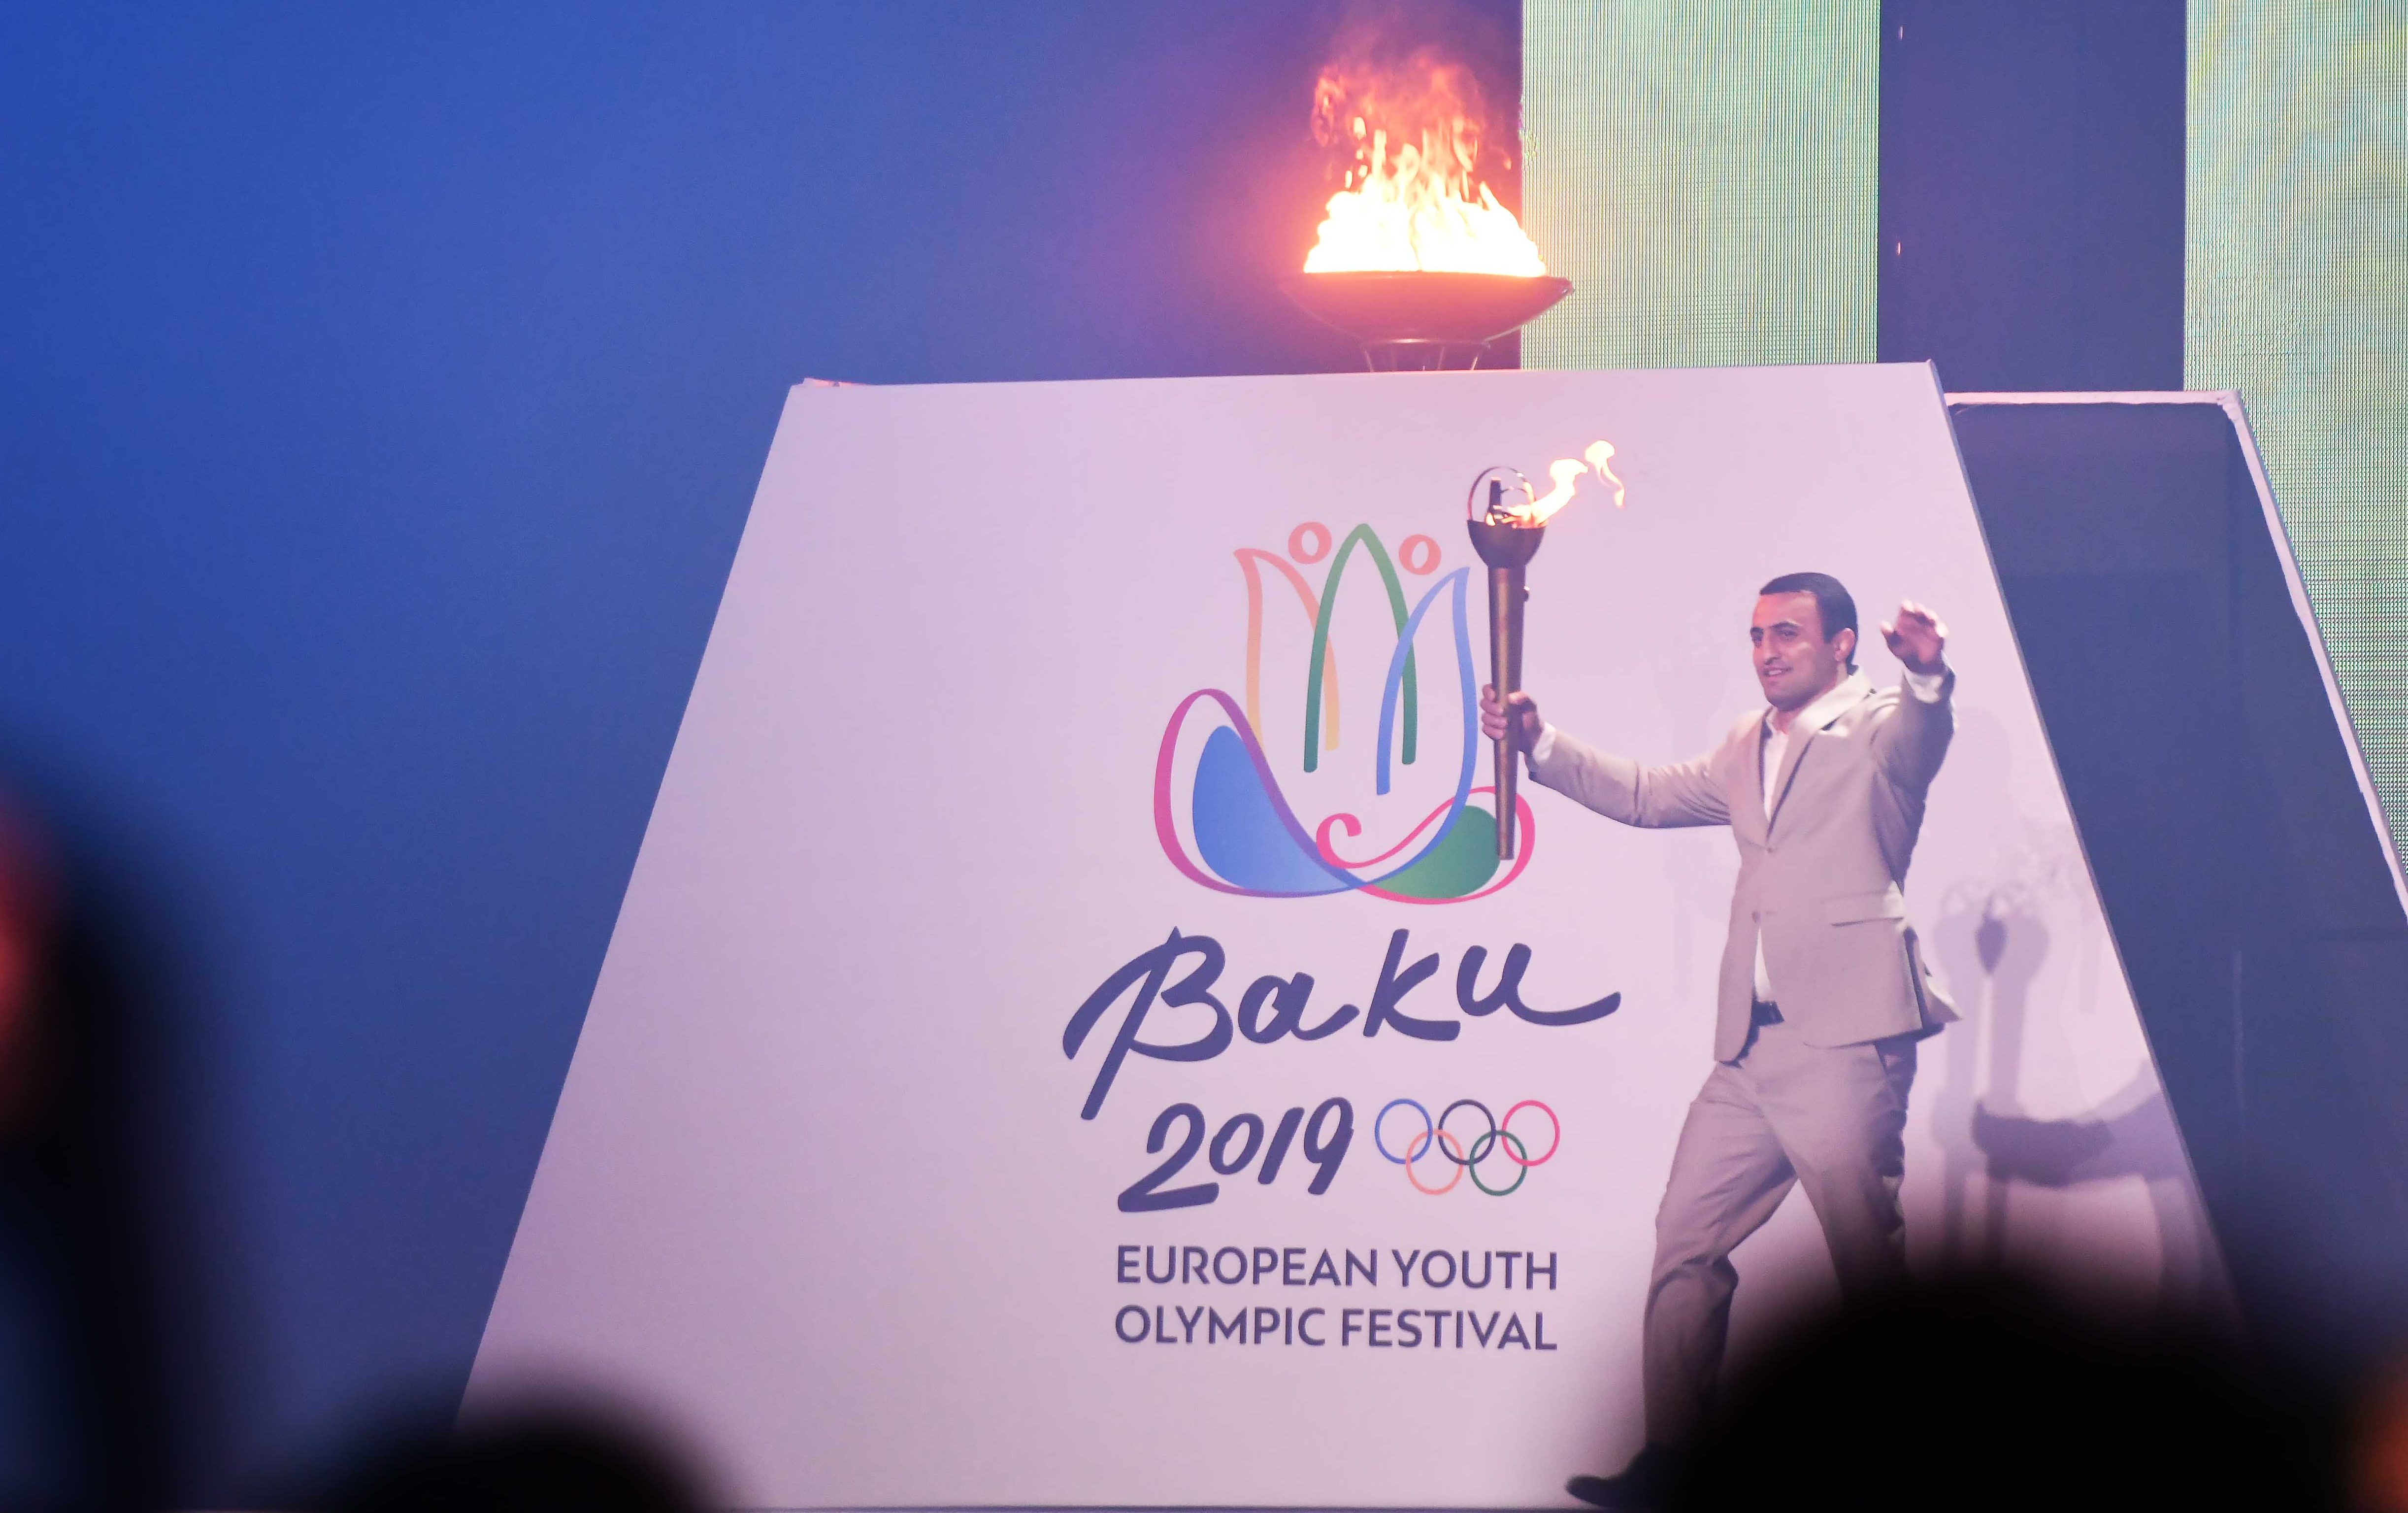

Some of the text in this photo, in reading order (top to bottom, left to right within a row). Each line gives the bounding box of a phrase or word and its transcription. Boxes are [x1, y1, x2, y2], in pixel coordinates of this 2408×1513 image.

[1063, 926, 1621, 1120] Baku
[1118, 1098, 1353, 1212] 2019
[1118, 1245, 1557, 1290] EUROPEAN YOUTH
[1115, 1305, 1557, 1350] OLYMPIC FESTIVAL
